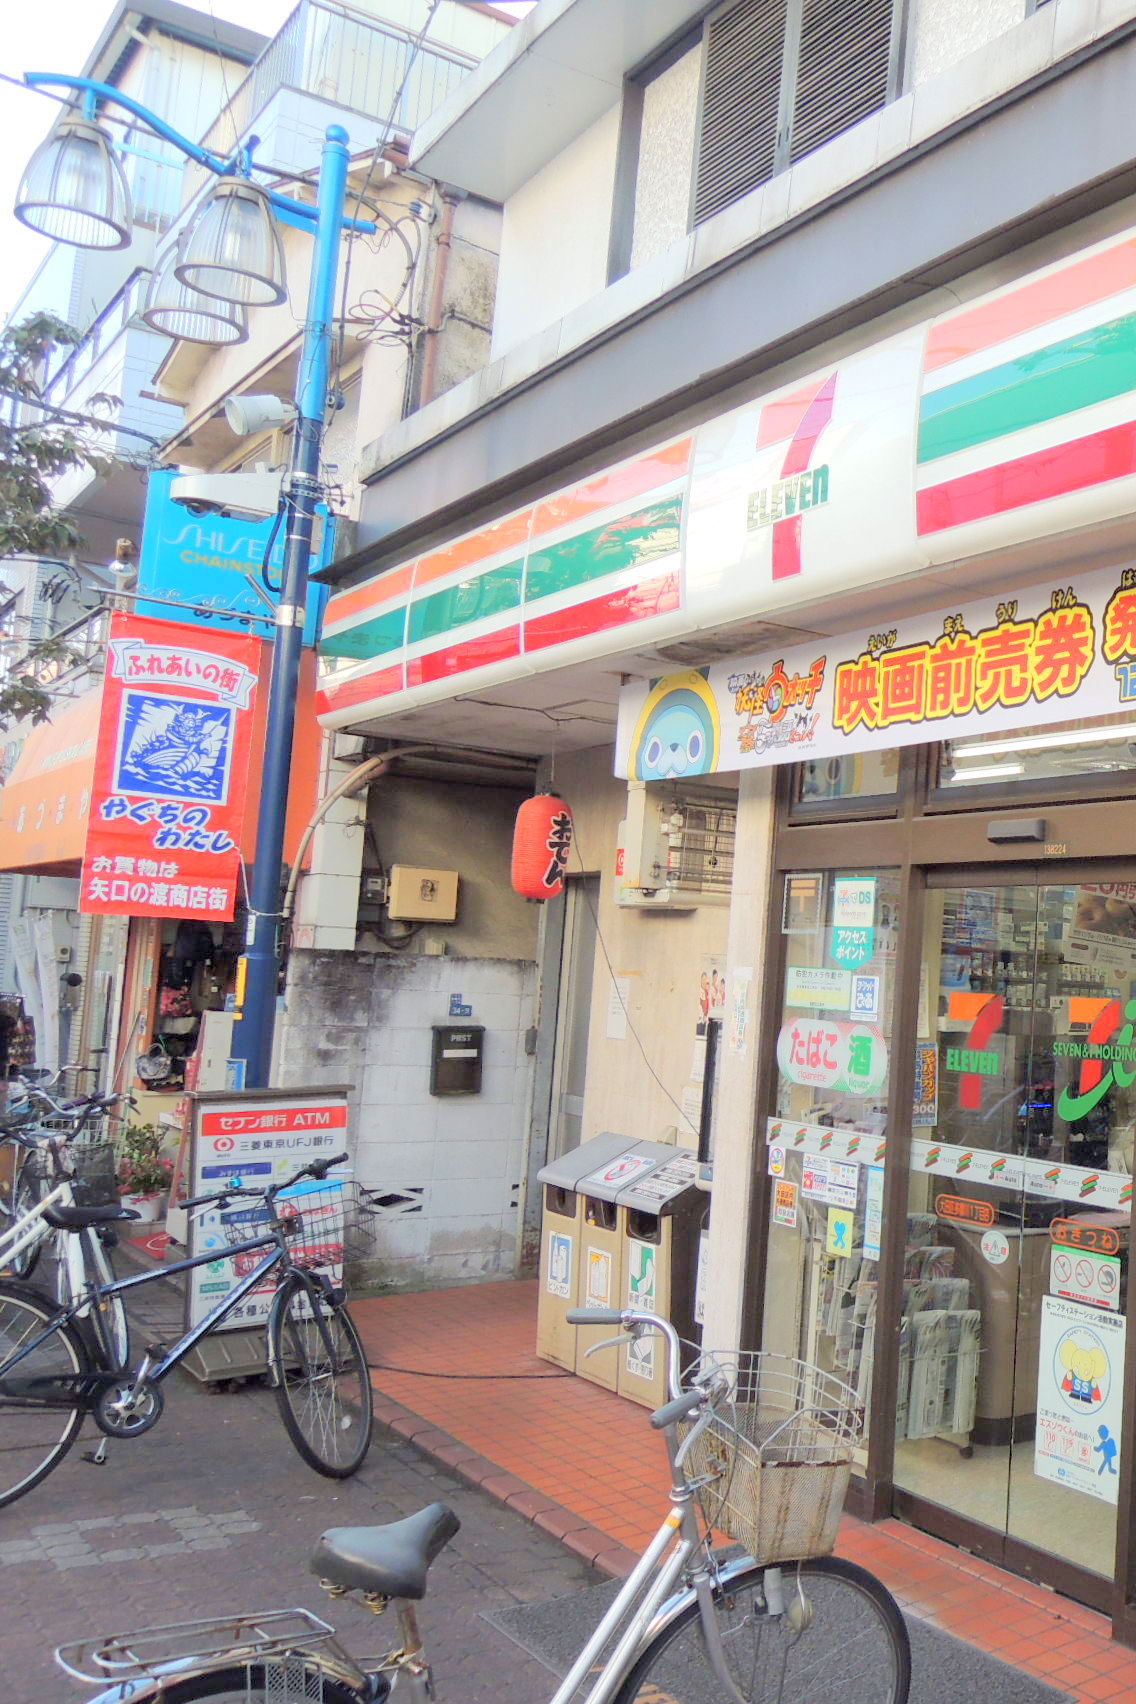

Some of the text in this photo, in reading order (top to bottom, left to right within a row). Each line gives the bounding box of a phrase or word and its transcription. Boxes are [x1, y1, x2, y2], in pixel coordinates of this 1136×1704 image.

[162, 524, 318, 571] SHISE
[128, 655, 240, 693] ふれあいの街
[833, 602, 1095, 735] 映画前売券
[102, 798, 209, 827] やぐちの
[155, 827, 235, 853] わたし
[91, 856, 179, 878] お買物は
[88, 880, 228, 910] 矢口の渡商店街
[837, 930, 868, 944] アクセス
[835, 945, 866, 961] ポイント
[790, 1027, 839, 1070] たばこ
[847, 1034, 873, 1077] 酒
[219, 1111, 331, 1130] セブン銀行 ATM
[239, 1135, 335, 1151] 三菱東京UFJ銀行
